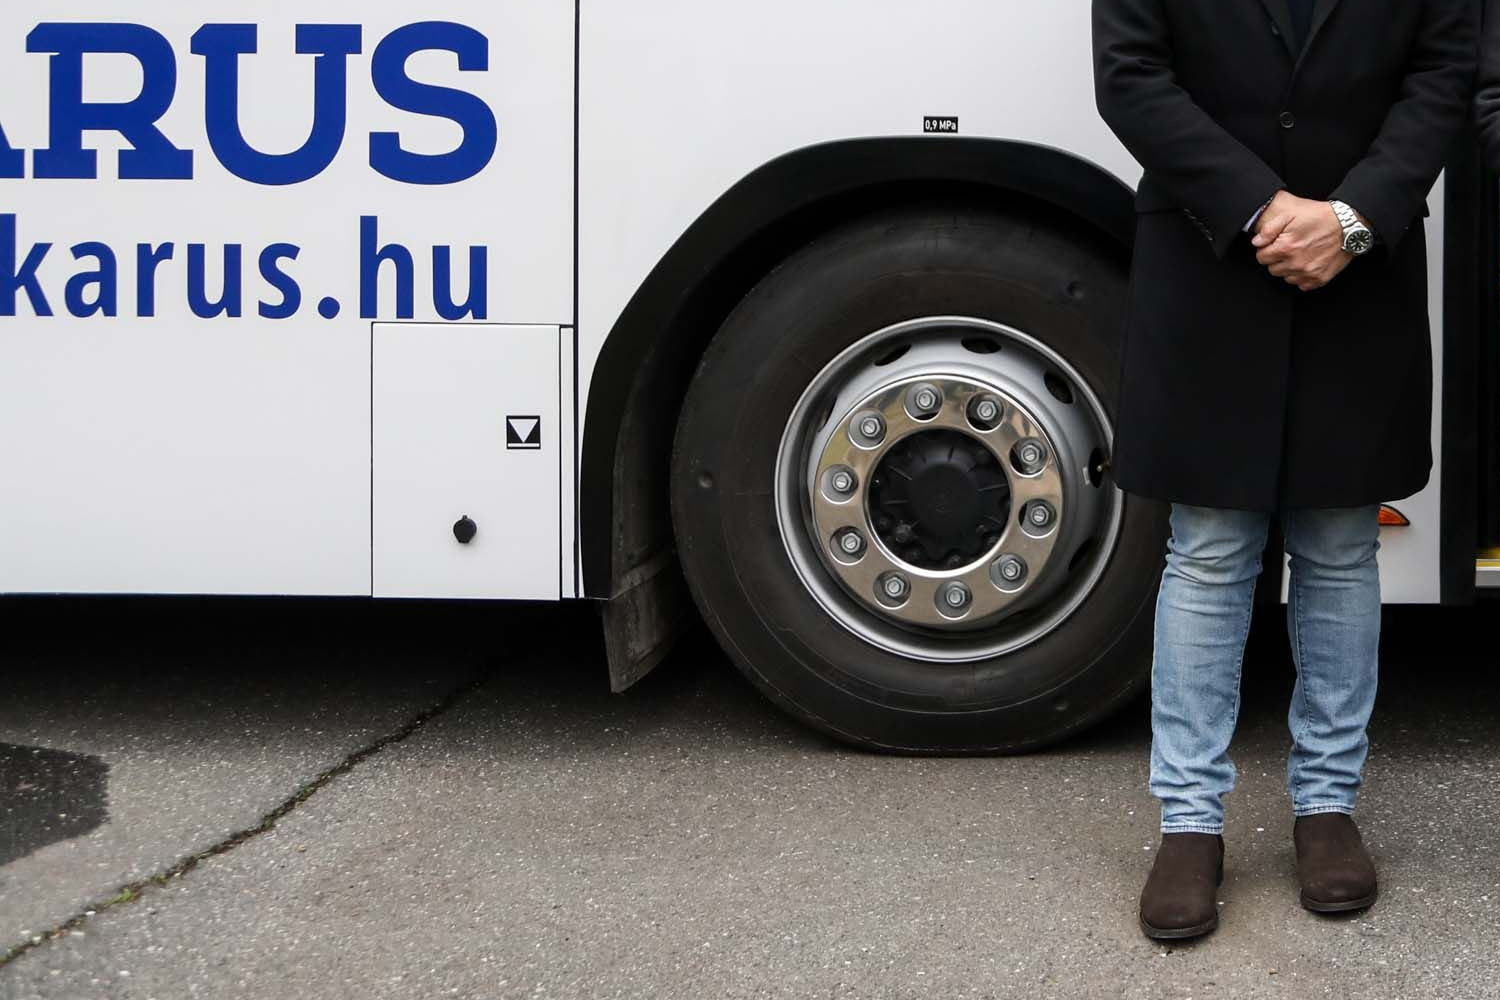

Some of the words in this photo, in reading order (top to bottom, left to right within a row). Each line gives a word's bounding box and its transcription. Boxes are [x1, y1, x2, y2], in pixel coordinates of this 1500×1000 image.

[0, 20, 497, 185] RUS
[939, 120, 957, 130] MPa
[0, 213, 488, 320] karus.hu
